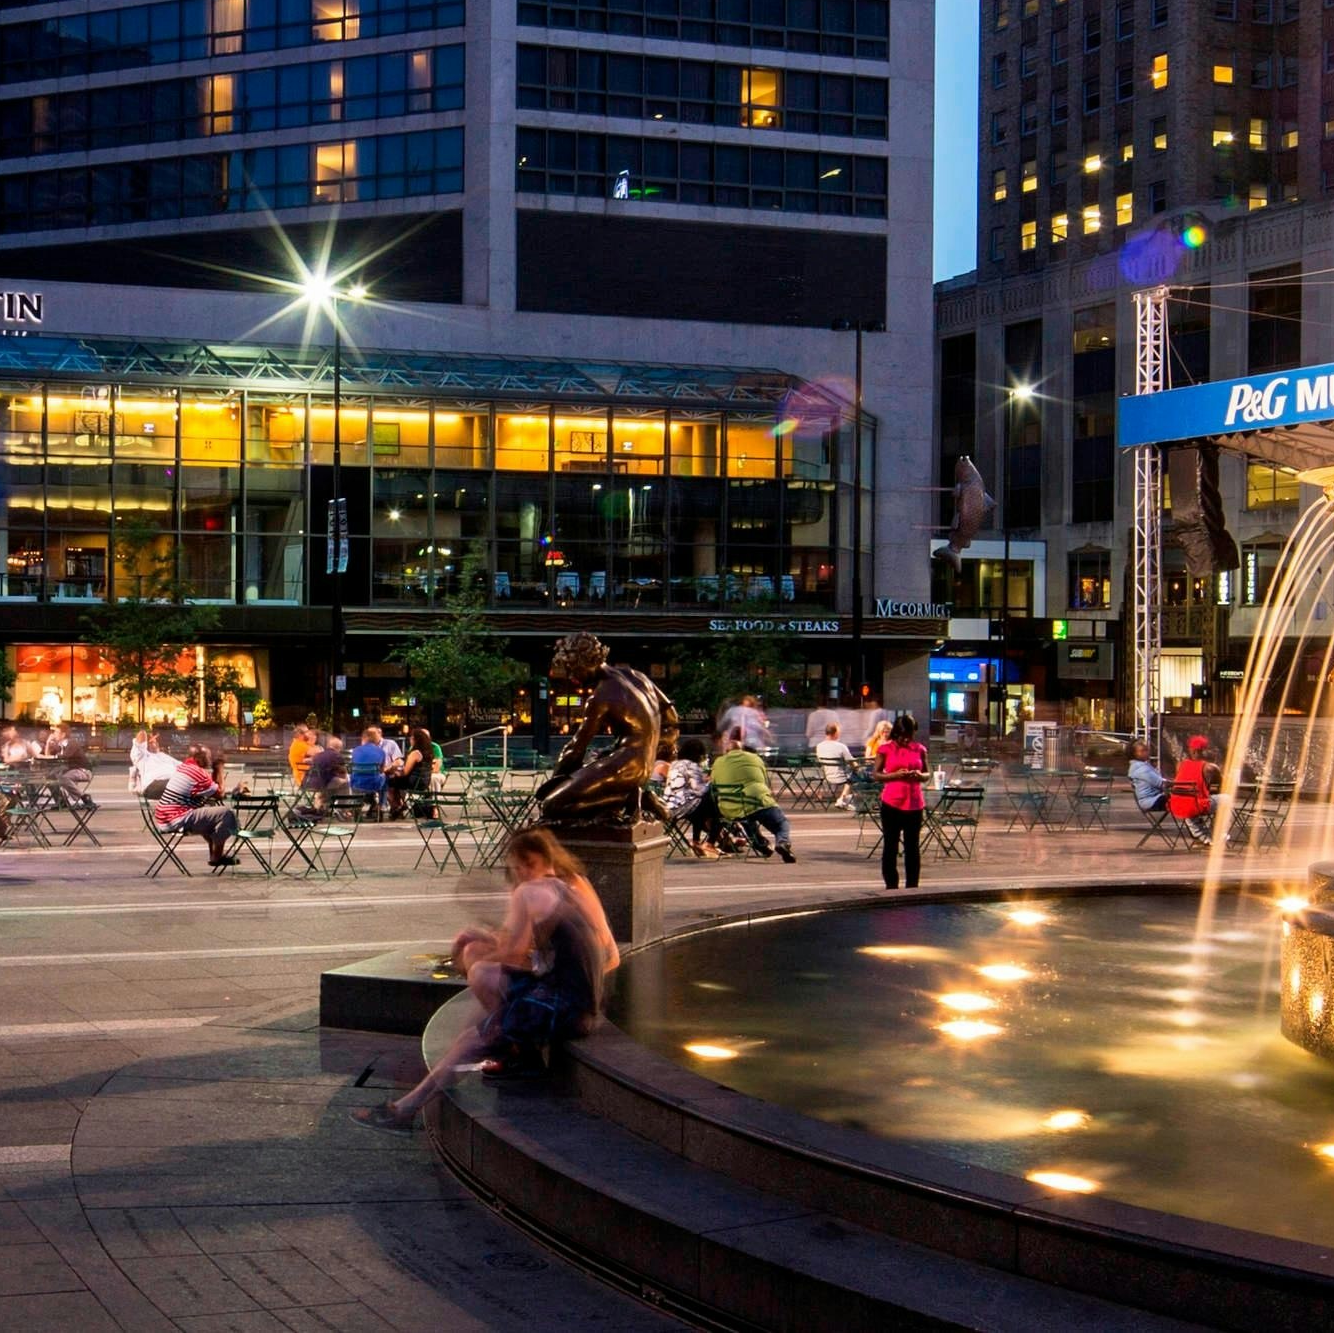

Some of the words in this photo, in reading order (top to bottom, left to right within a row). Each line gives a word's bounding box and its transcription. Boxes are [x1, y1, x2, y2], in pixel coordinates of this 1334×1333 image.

[1224, 376, 1289, 426] P&G
[709, 619, 774, 632] SEAFOOD
[788, 620, 840, 633] STEAKS
